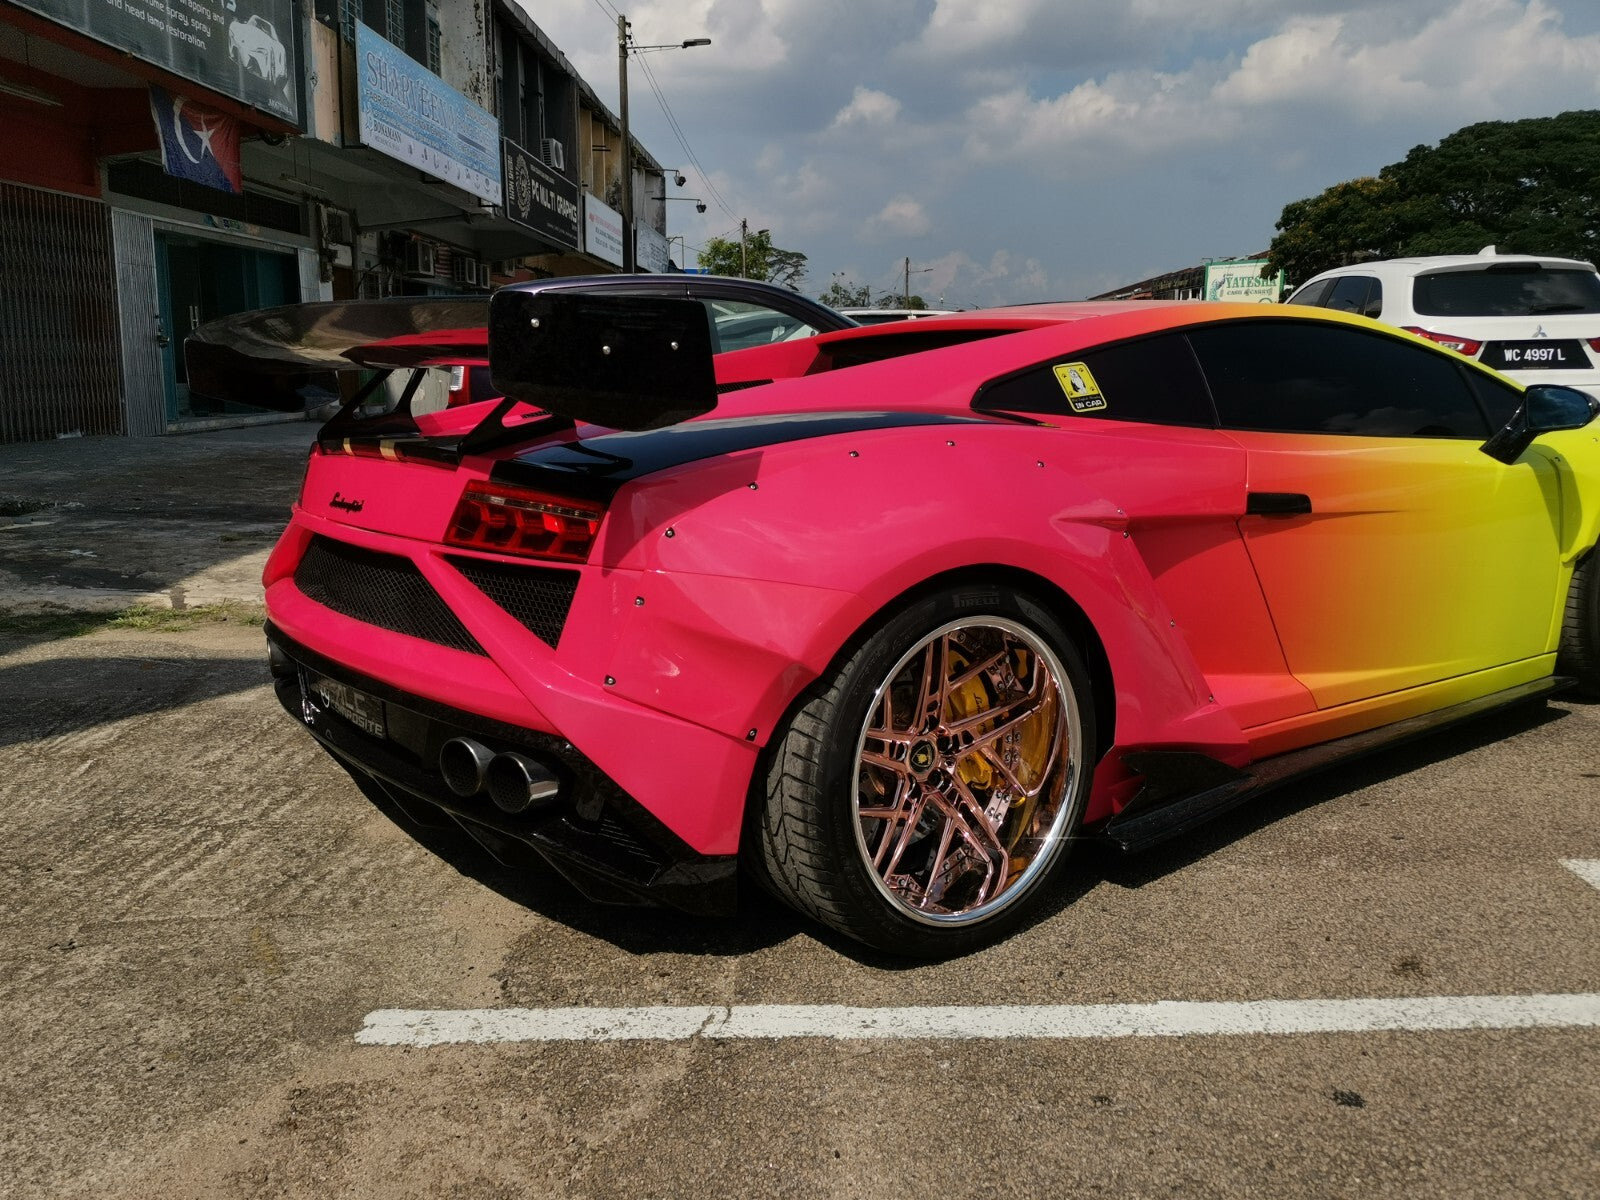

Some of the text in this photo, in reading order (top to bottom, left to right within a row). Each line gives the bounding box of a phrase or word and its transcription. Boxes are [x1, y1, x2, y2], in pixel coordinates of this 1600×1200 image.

[125, 1, 145, 20] head
[147, 12, 165, 31] lamp
[212, 11, 225, 25] and
[191, 18, 211, 38] spray
[1504, 348, 1566, 361] WC 4997 L
[1075, 399, 1102, 409] IN CAR
